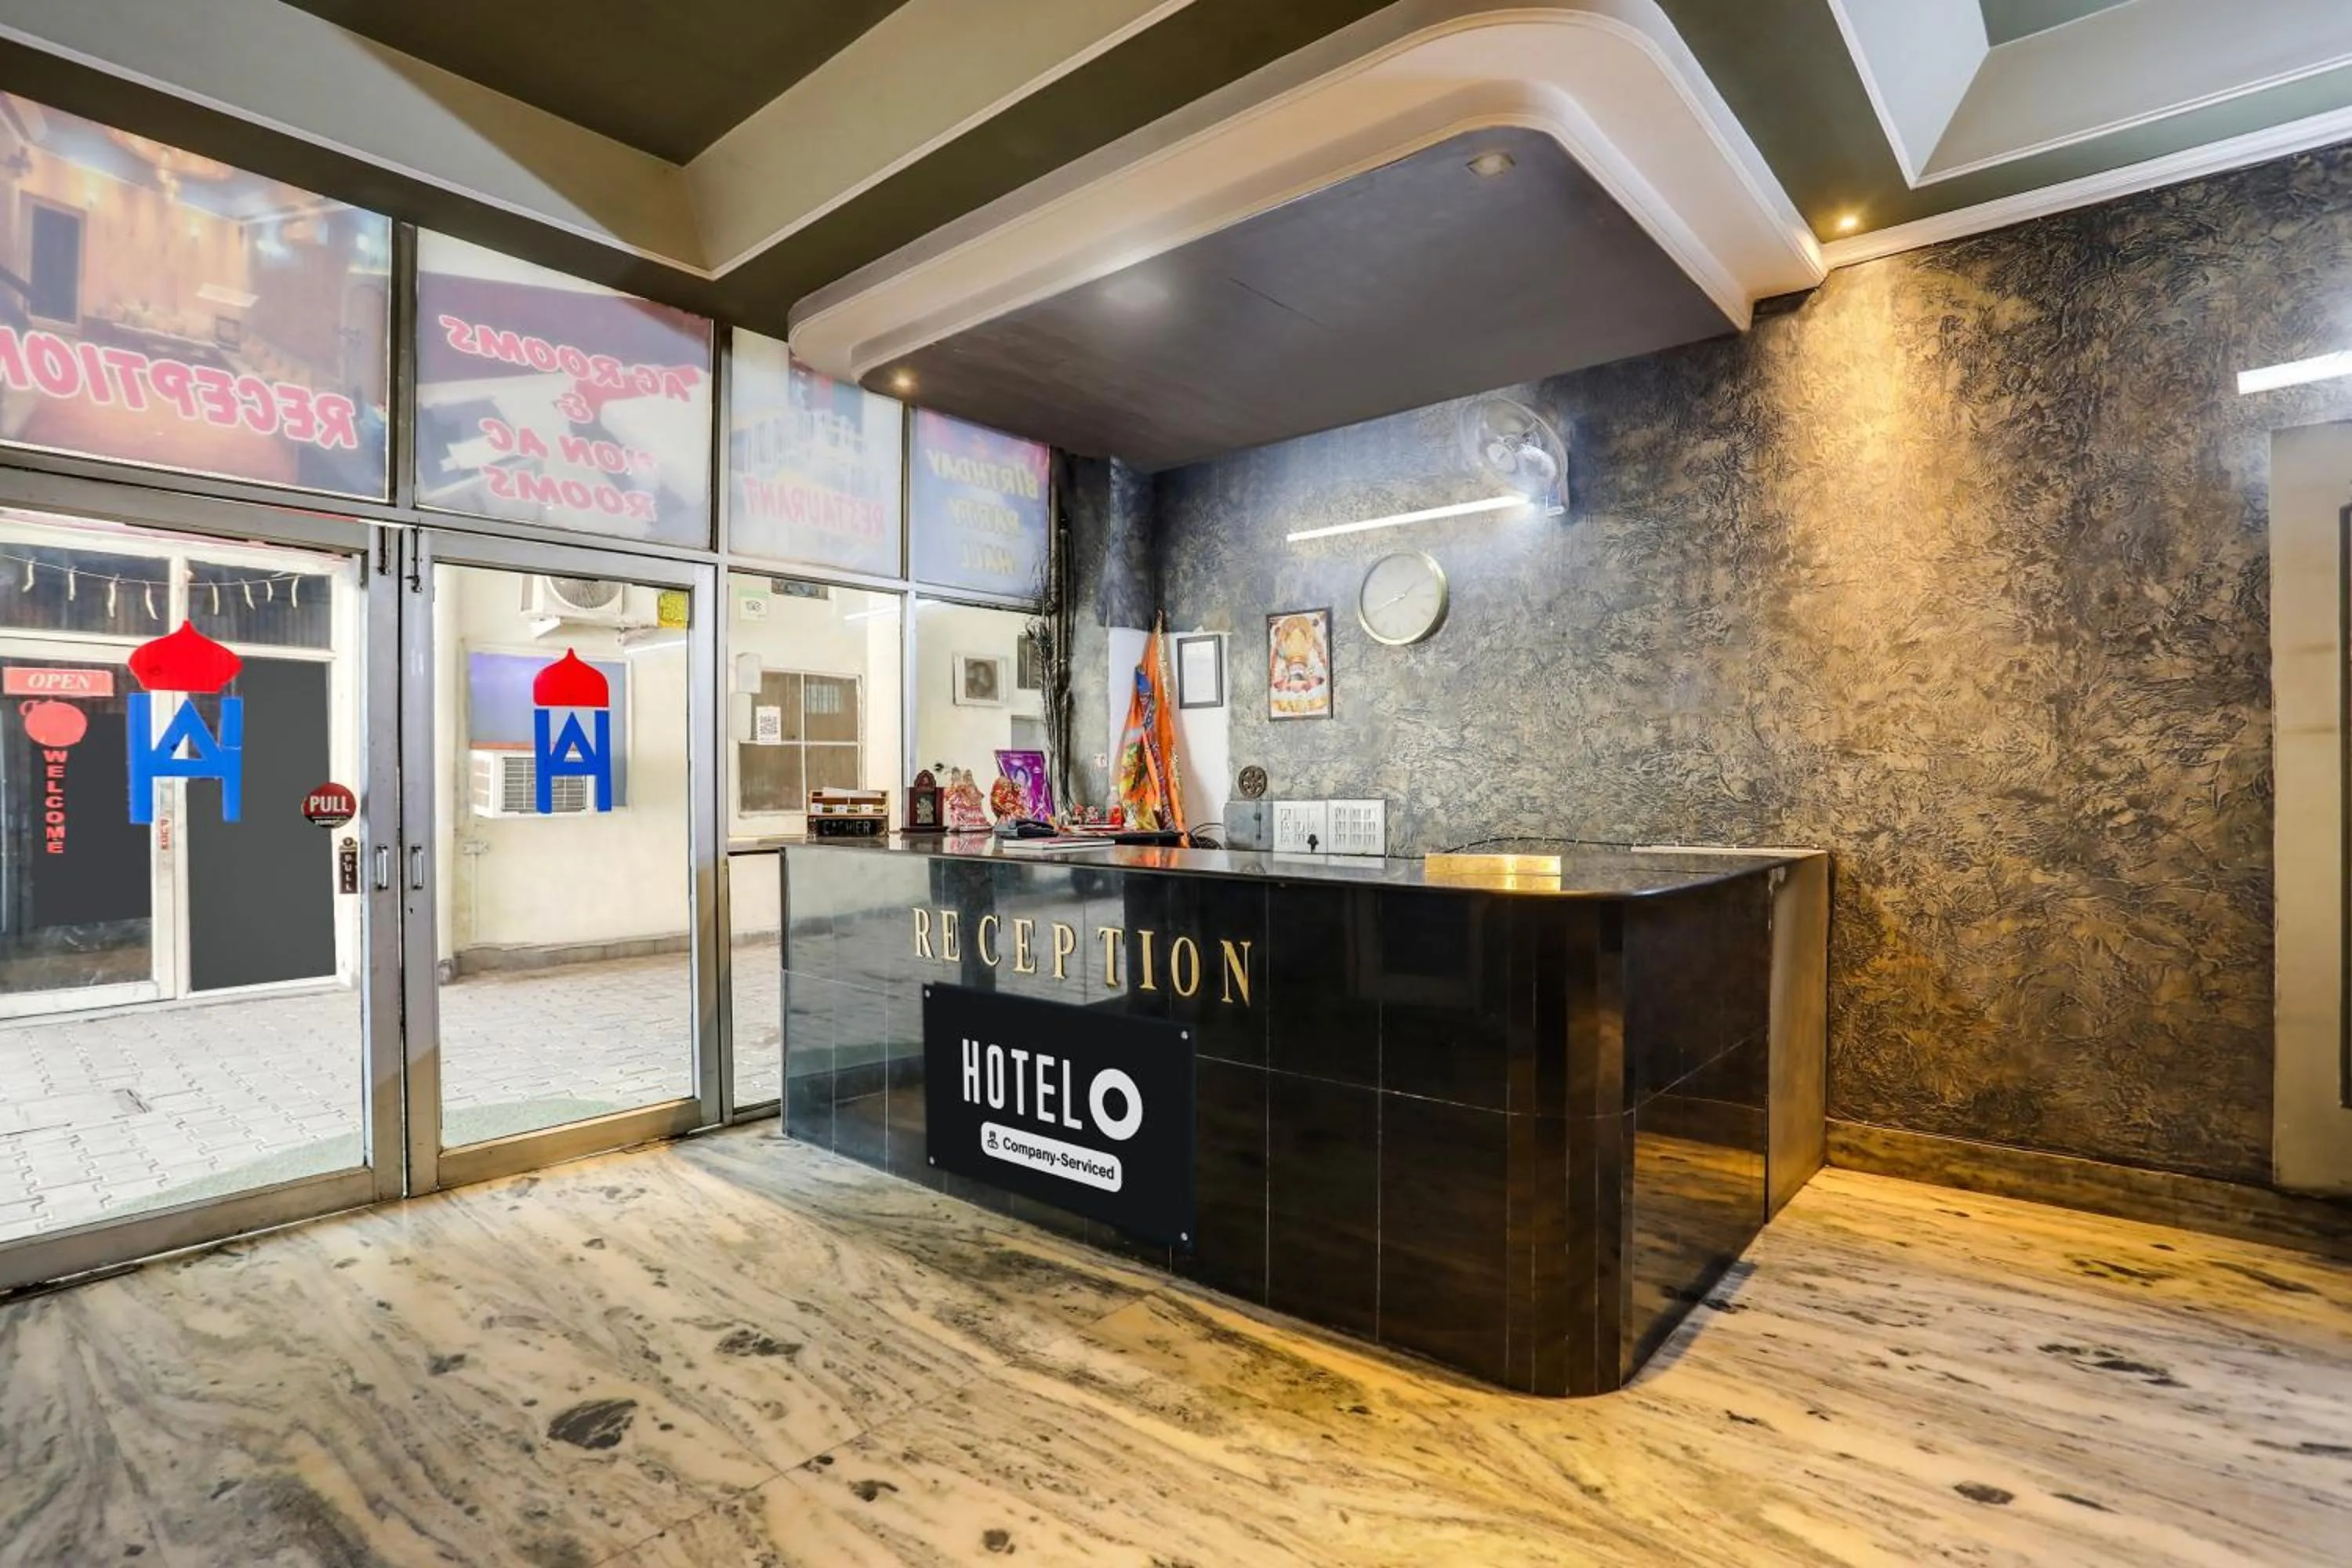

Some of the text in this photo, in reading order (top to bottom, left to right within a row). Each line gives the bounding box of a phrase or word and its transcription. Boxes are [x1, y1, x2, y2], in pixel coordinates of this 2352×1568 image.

[27, 673, 91, 690] OPEN
[44, 750, 68, 854] WELCOME
[309, 796, 350, 812] PULL
[912, 906, 1252, 1008] RECEPTION
[962, 1038, 1083, 1131] HOTEL
[1003, 1137, 1115, 1181] Company-Serviced
